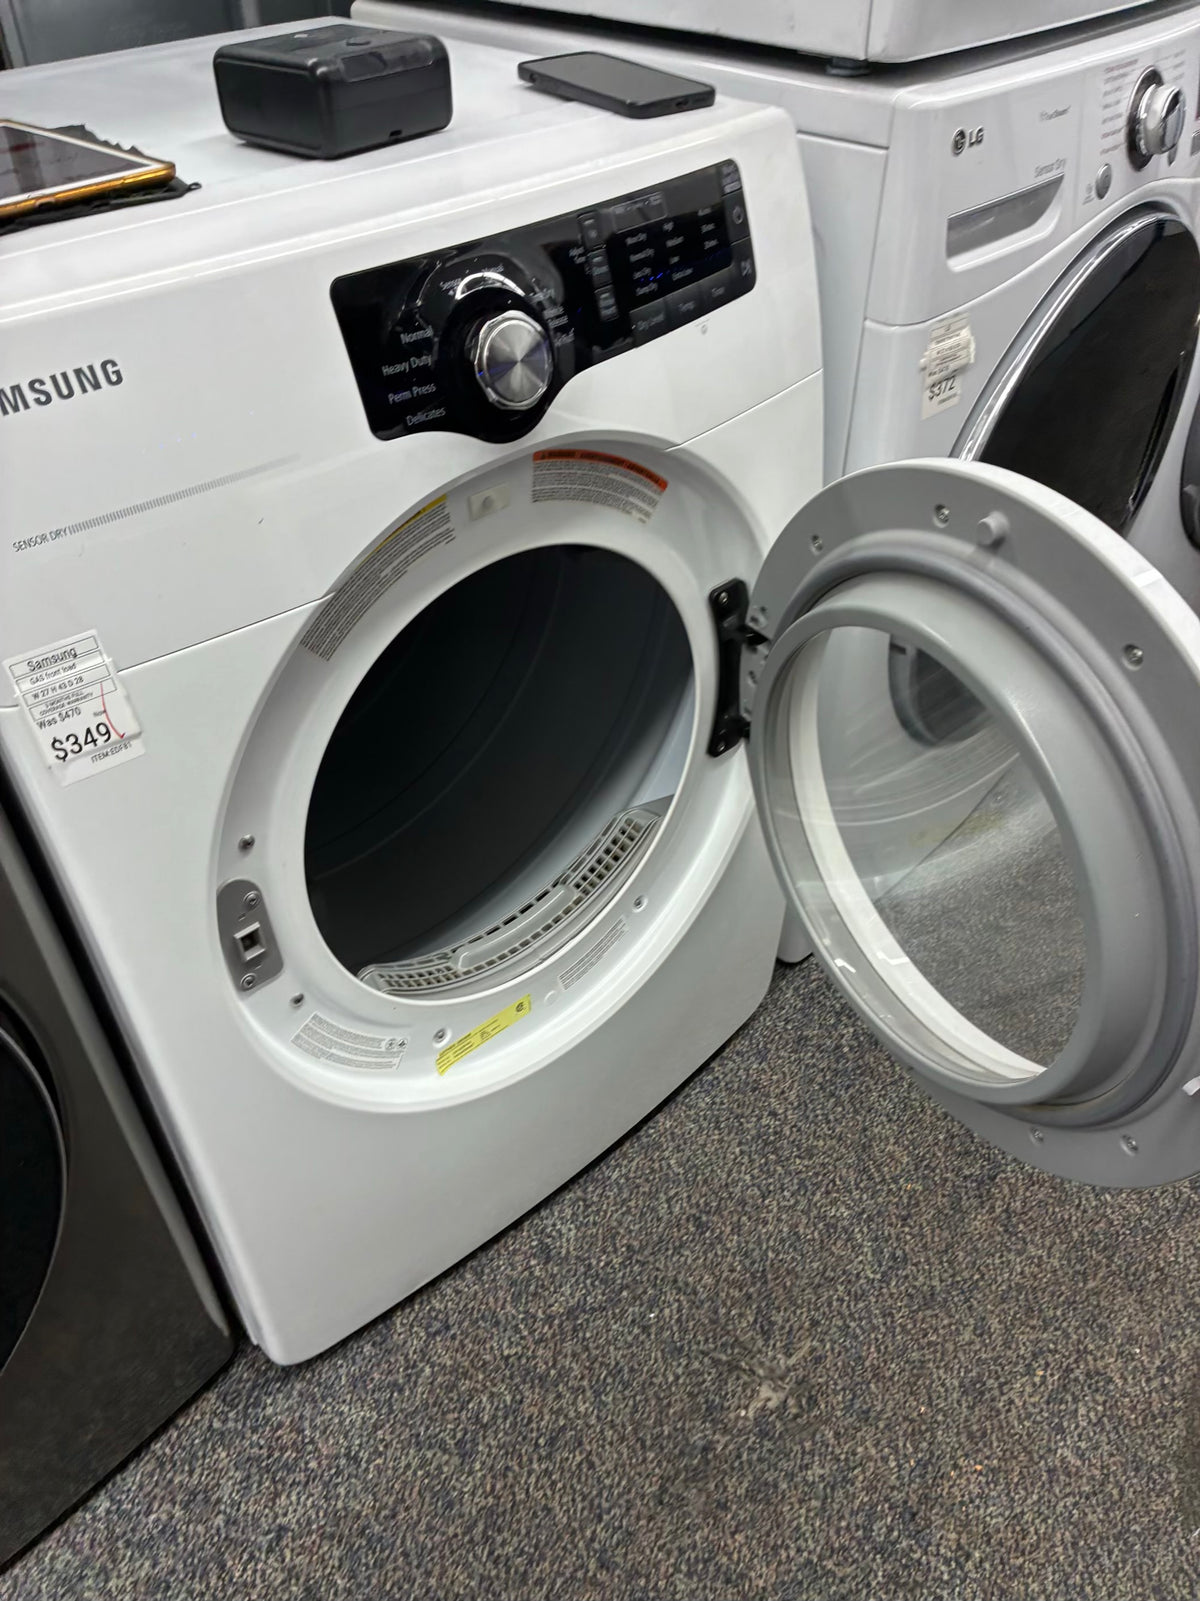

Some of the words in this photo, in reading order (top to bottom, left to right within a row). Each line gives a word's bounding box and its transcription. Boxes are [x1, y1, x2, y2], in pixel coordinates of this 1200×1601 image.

[400, 325, 434, 345] Normal
[382, 360, 409, 376] Heavy
[410, 354, 433, 368] Duty
[0, 358, 124, 416] MSUNG
[388, 391, 411, 404] Perm
[412, 383, 437, 398] Press
[405, 406, 446, 426] Delicates
[12, 532, 49, 552] SENSOR
[49, 526, 69, 542] DRY
[26, 647, 78, 673] Samsung
[45, 666, 62, 681] front
[40, 689, 50, 699] 27
[36, 716, 58, 730] Was
[51, 722, 112, 763] $349
